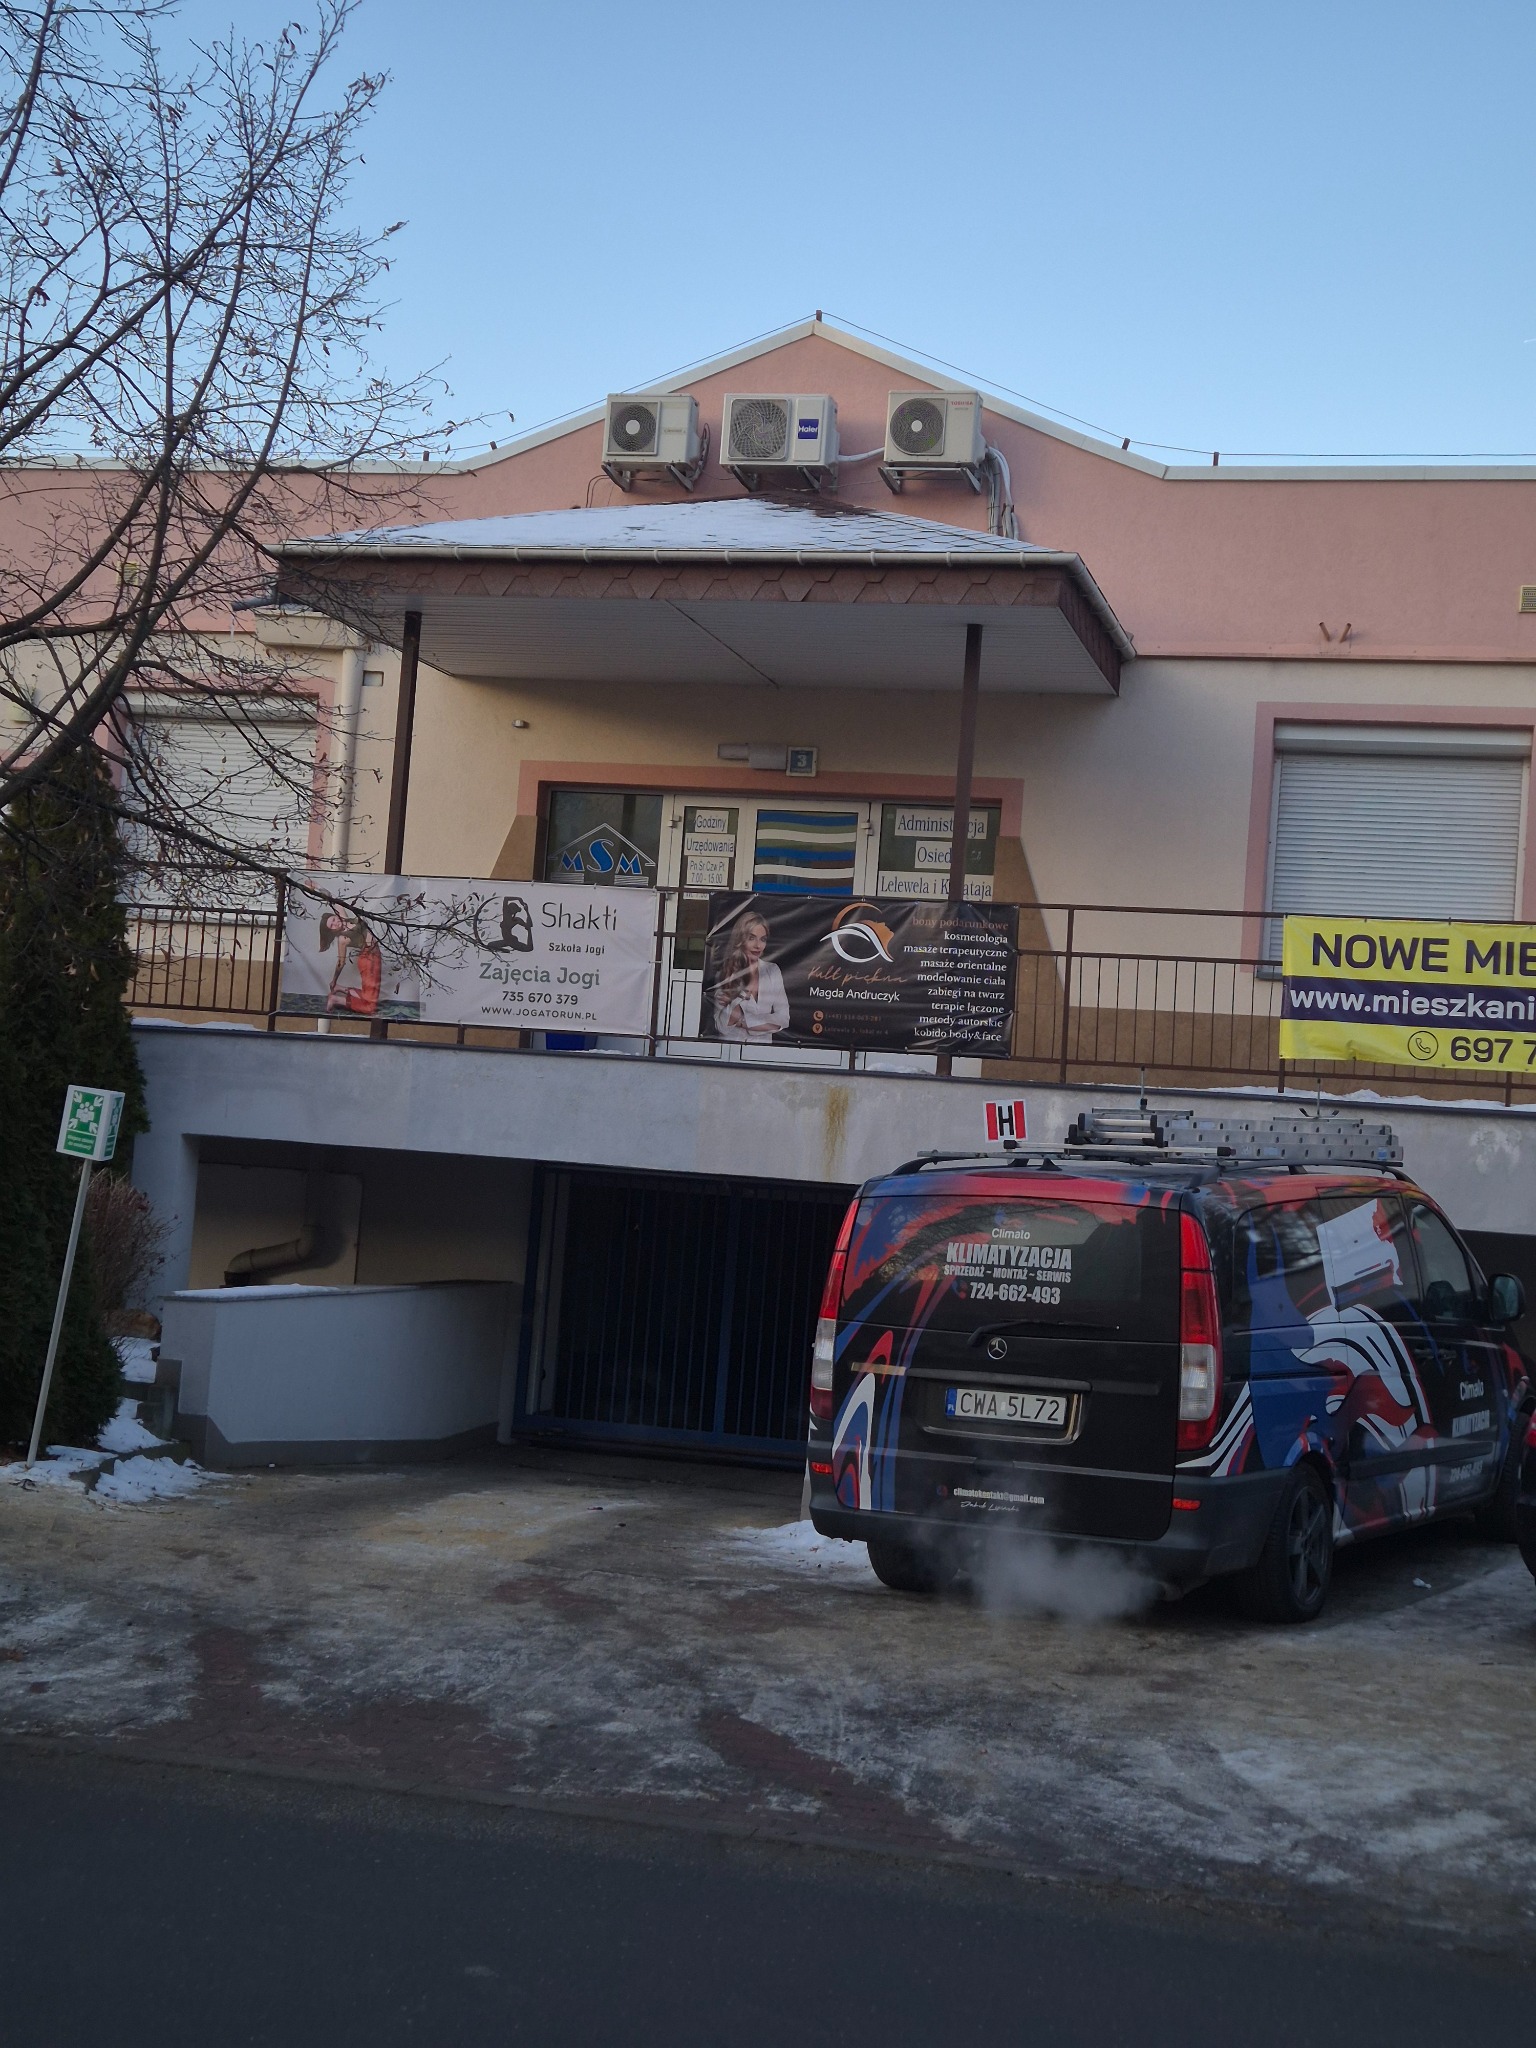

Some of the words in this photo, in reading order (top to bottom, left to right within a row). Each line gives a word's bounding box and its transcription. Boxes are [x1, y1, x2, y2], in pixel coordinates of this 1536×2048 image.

[798, 425, 818, 433] Haier
[797, 754, 807, 767] 3
[696, 815, 727, 832] Godziny
[897, 814, 985, 838] Administcja
[686, 838, 734, 854] Urzędowania
[561, 838, 642, 875] MSM
[881, 876, 929, 893] Lelewela
[933, 880, 937, 894] i
[541, 902, 617, 931] Shakti
[912, 917, 937, 928] bony
[940, 918, 1009, 930] podarunkowe
[944, 931, 1008, 945] kosmetologia
[549, 942, 582, 953] Szkoła
[585, 945, 605, 956] Jogi
[903, 944, 938, 954] masaże
[940, 946, 1008, 958] terapeutyczne
[1312, 932, 1450, 973] NOWE
[920, 959, 955, 968] masaże
[957, 960, 1007, 971] orientalne
[479, 962, 551, 985] Zajęcia
[557, 967, 600, 989] Jogi
[917, 973, 982, 984] modelowanie
[984, 976, 1006, 986] ciała
[502, 991, 524, 1002] 735
[528, 992, 552, 1004] 670
[555, 994, 578, 1005] 379
[809, 987, 844, 999] Magda
[846, 989, 900, 1003] Andruczyk
[927, 987, 962, 999] zabiegi
[964, 990, 976, 998] na
[978, 991, 1005, 1000] twarz
[481, 1006, 598, 1020] WWW.JOGATORUN.PL
[931, 1002, 965, 1013] terapie
[967, 1002, 1005, 1014] łączone
[1290, 989, 1535, 1021] www.mieszkani
[919, 1016, 956, 1027] metody
[957, 1018, 1003, 1028] autorskie
[914, 1027, 947, 1038] kobido
[949, 1029, 1002, 1042] body&face
[1450, 1036, 1513, 1063] 697
[997, 1104, 1015, 1137] H
[991, 1227, 1031, 1240] Climato
[946, 1242, 1072, 1270] KLIMATYZACJA
[943, 1264, 985, 1278] SPRZEDAŻ
[993, 1267, 1028, 1280] MONTAŻ
[1036, 1270, 1071, 1283] SERWIS
[970, 1282, 1061, 1305] 724-662-493
[947, 1403, 955, 1411] PL
[960, 1392, 998, 1416] CWA
[1007, 1396, 1060, 1422] 5L72
